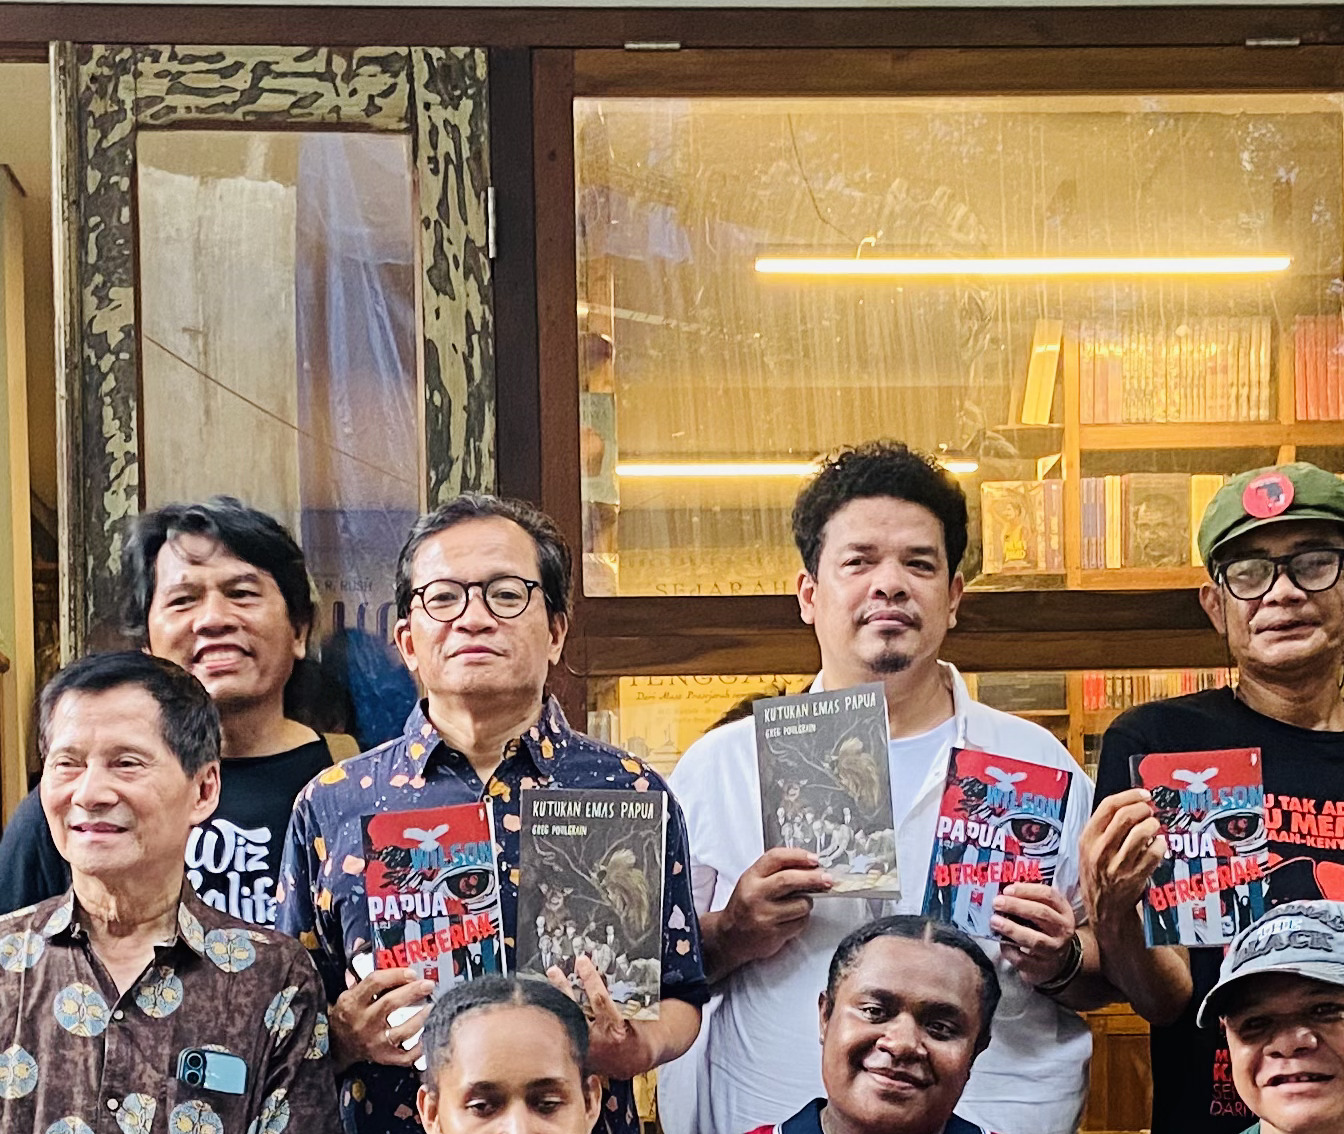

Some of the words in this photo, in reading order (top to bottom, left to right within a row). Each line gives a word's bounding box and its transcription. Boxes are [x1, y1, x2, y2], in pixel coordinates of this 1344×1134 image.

[763, 705, 809, 723] KUTUKAN
[812, 699, 840, 717] EMAS
[844, 692, 877, 711] PAPUA
[532, 800, 582, 818] KUTUKAN
[585, 801, 615, 819] EMAS
[620, 802, 654, 820] PAPUA
[986, 784, 1062, 819] WILSON
[1179, 784, 1265, 813] WILSON
[1278, 795, 1317, 815] TAK
[184, 818, 272, 874] Wiz
[937, 815, 1006, 850] PAPUA
[1157, 833, 1216, 860] APUA
[409, 841, 494, 870] WILSON
[934, 858, 1043, 887] BERGERAK
[1148, 857, 1265, 912] BERGERAK
[368, 892, 449, 922] PAPUA
[376, 912, 499, 970] BERGERAK
